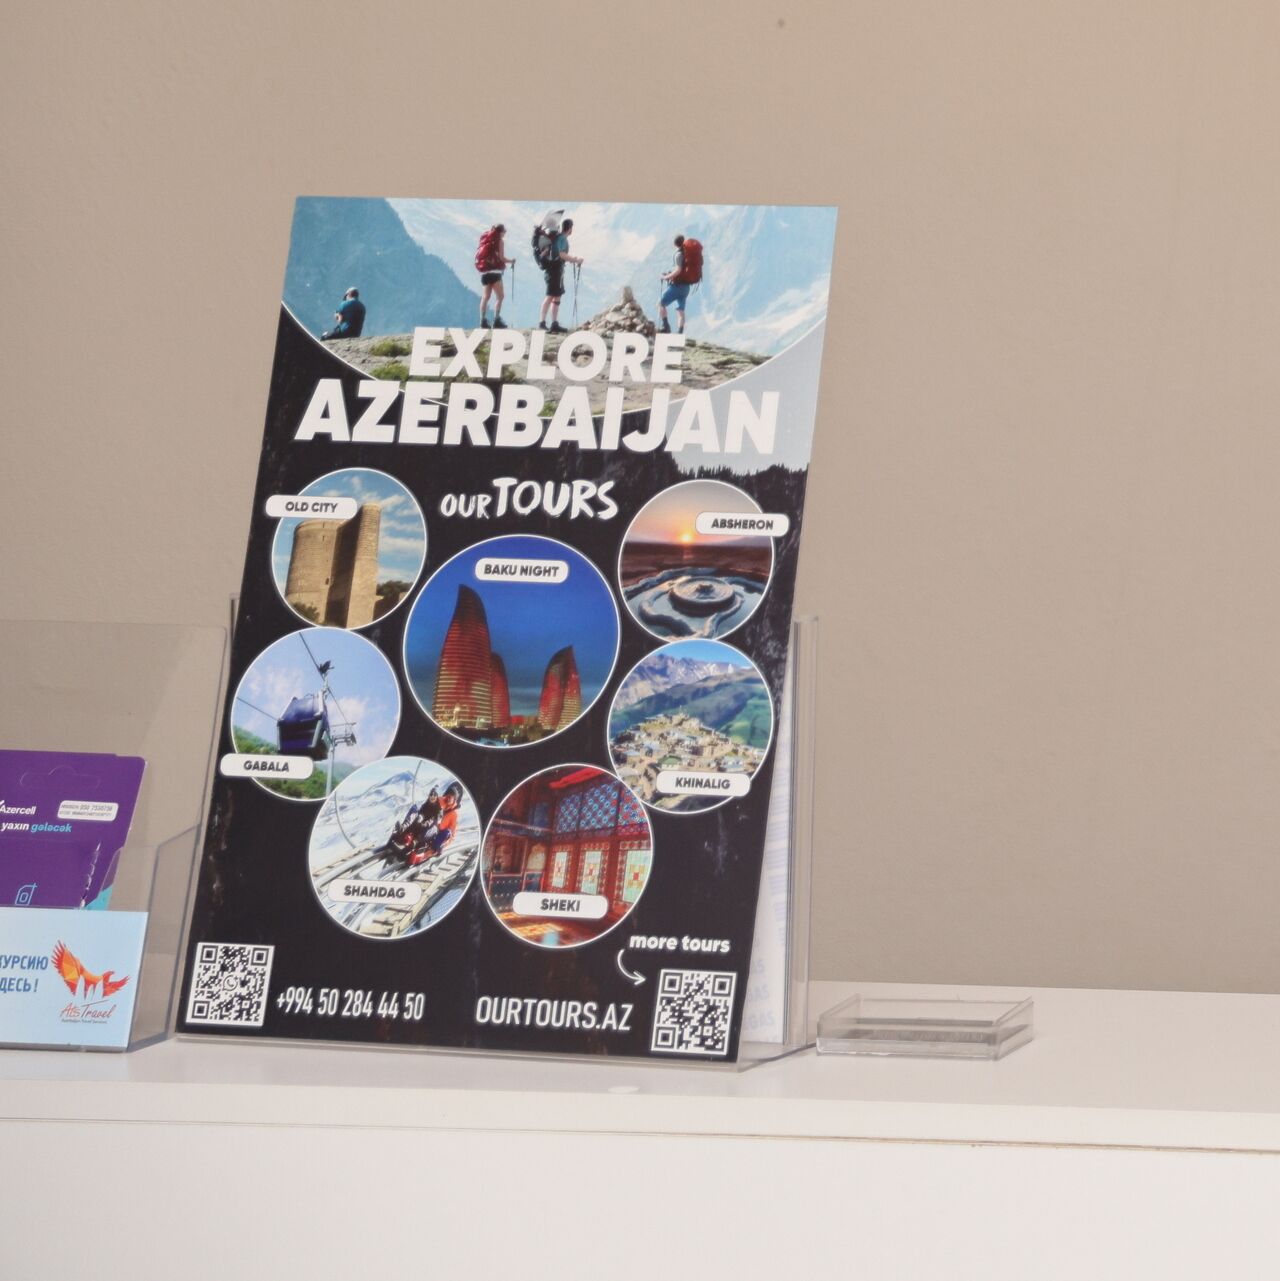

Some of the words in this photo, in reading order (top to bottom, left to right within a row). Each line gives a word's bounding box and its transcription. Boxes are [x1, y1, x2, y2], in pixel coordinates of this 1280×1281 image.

[408, 326, 687, 385] EXPLORE
[293, 378, 781, 455] AZERBAIJAN
[440, 493, 492, 520] OUR
[492, 477, 619, 520] TOURS
[285, 501, 309, 512] OLD
[311, 502, 338, 513] CITY
[711, 518, 774, 531] ABSHERON
[484, 564, 517, 576] BAKU
[519, 564, 559, 577] NIGHT
[243, 759, 290, 774] GABALA
[675, 776, 731, 790] KHINALIG
[343, 885, 406, 899] SHAHDAG
[540, 898, 581, 913] SHEKI
[629, 935, 679, 950] more
[682, 936, 731, 952] tours
[276, 986, 314, 1014] +994
[318, 988, 339, 1016] 50
[341, 990, 373, 1018] 284
[377, 991, 399, 1019] 44
[403, 992, 425, 1020] 50
[475, 996, 635, 1032] OURTOURS.AZ
